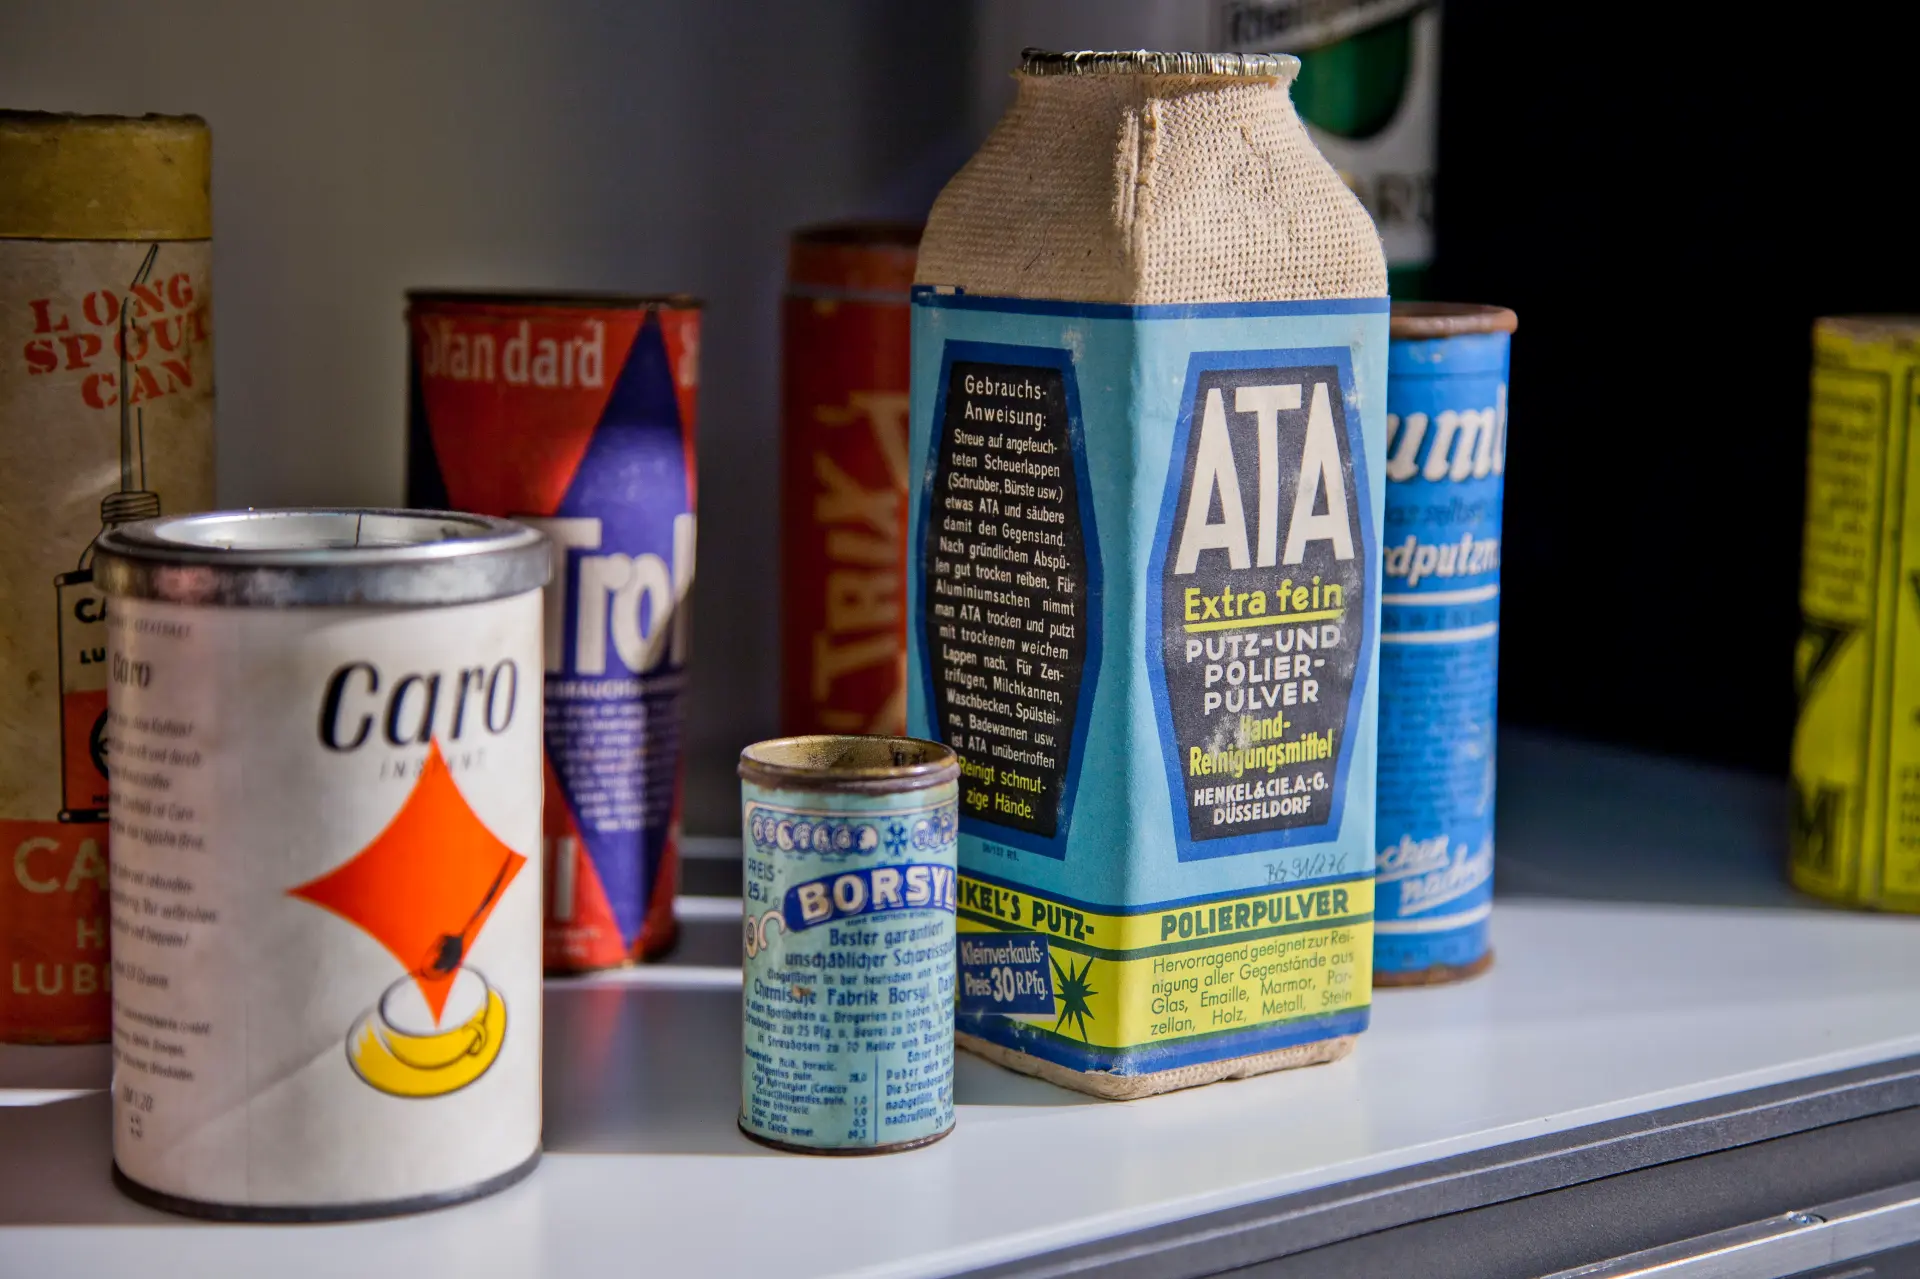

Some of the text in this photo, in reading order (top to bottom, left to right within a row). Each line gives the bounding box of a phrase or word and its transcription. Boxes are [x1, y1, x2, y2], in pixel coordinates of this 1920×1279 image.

[28, 273, 194, 334] LONG
[81, 355, 195, 410] CAN
[965, 374, 1047, 400] Gebrauchs-
[964, 401, 1047, 432] Anweisung:
[954, 429, 1057, 454] Streue auf angefeuch-
[952, 452, 1060, 479] teten Scheuerlappen
[1174, 382, 1354, 575] ATA
[948, 472, 1063, 503] (Schrubber, Bürste usw.)
[945, 497, 1065, 524] etwas ATA und säubere
[944, 516, 1066, 548] damit den Gegenstand.
[939, 536, 1070, 572] Nach gründlichem Abspü-
[935, 557, 1075, 593] len gut trocken reiben. Für
[935, 578, 1074, 617] Aluminiumsachen nimmt
[1184, 576, 1344, 621] Extra fein
[935, 603, 1075, 639] man ATA trocken und putzt
[939, 624, 1069, 660] mit trockenem weichem
[1185, 624, 1341, 663] PUTZ-UND
[943, 644, 1064, 682] Lappen nach. Für Zen-
[1204, 654, 1326, 688] POLIER-
[944, 668, 1063, 705] trifugen, Milchkannen,
[1204, 679, 1319, 715] PULVER
[317, 660, 518, 753] Caro
[947, 688, 1061, 725] Waschbecken, Spülstei-
[969, 714, 1028, 741] Badewannen
[1035, 732, 1057, 748] usw.
[1240, 711, 1290, 743] Hand-
[951, 733, 1055, 769] ist ATA unübertroffen
[1189, 728, 1333, 779] Reinigungsmittel
[959, 756, 1047, 794] Reinigt schmut-
[967, 788, 1035, 820] zige Hände.
[1213, 796, 1311, 825] DÜSSELDORF
[797, 866, 955, 924] BORSYL
[1032, 900, 1096, 941] PUTZ-
[1161, 888, 1349, 941] POLIERPULVER
[829, 927, 879, 947] Bester
[960, 940, 1044, 965] Kleinverkaufs-
[1154, 929, 1355, 974] Hervorragend geeignet zur Rei-
[964, 969, 992, 997] Preis
[991, 966, 1016, 1002] 30
[1152, 976, 1198, 997] nigung
[1204, 967, 1234, 987] aller
[1240, 953, 1326, 981] Gegenstände
[1331, 951, 1354, 966] aus
[827, 987, 878, 1006] Fabrik
[1151, 990, 1352, 1036] zellan, Holz, Metall, Stein
[1152, 996, 1189, 1016] Glas,
[1200, 986, 1250, 1008] Emaille,
[1260, 976, 1316, 997] Marmor,
